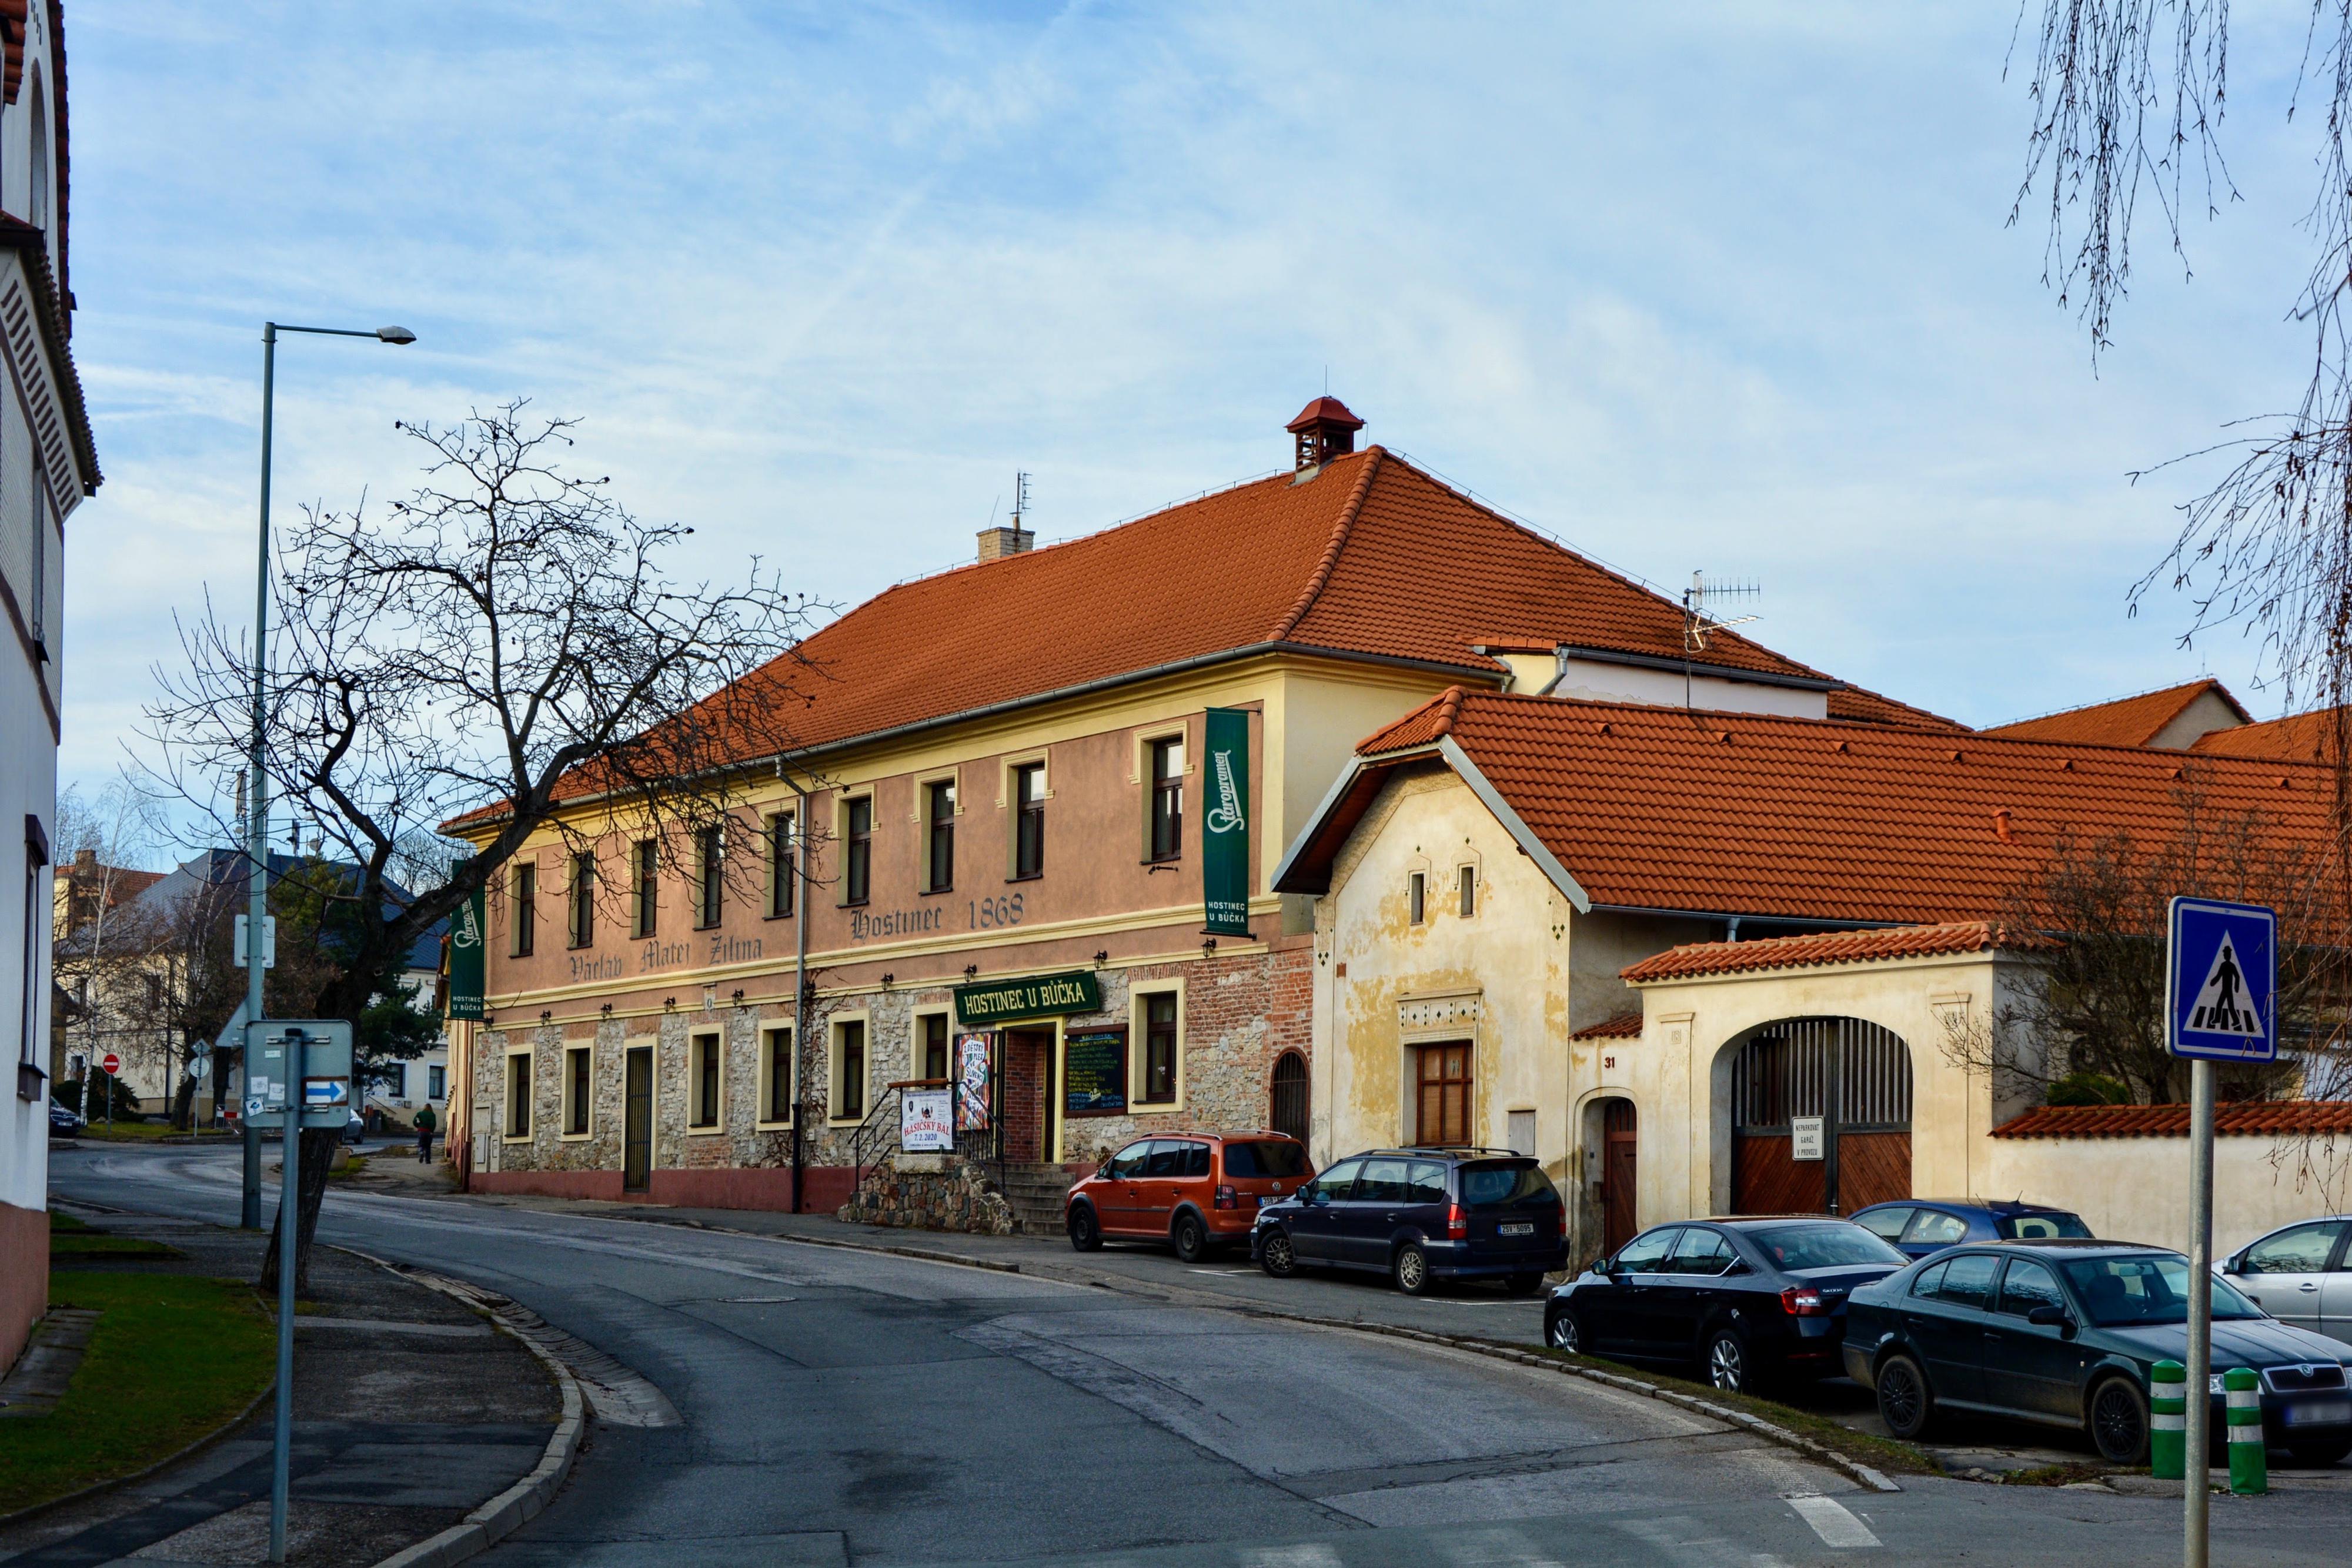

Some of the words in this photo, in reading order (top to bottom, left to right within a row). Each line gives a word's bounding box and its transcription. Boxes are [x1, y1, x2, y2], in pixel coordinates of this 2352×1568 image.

[1208, 750, 1244, 833] Staropramen
[1208, 902, 1245, 911] HOSTINEC
[851, 907, 941, 944] Hostinec
[970, 893, 1023, 930] 1868
[1210, 913, 1215, 921] U
[1218, 911, 1245, 923] BŮČKA
[964, 989, 1025, 1015] HOSTINEC
[1027, 988, 1037, 1007] U
[1040, 979, 1085, 1006] BŮČKA
[460, 1002, 481, 1011] BŮČKA
[1605, 1057, 1615, 1068] 31
[904, 1119, 936, 1136] HASIČSKÝ
[937, 1122, 949, 1135] BÁL
